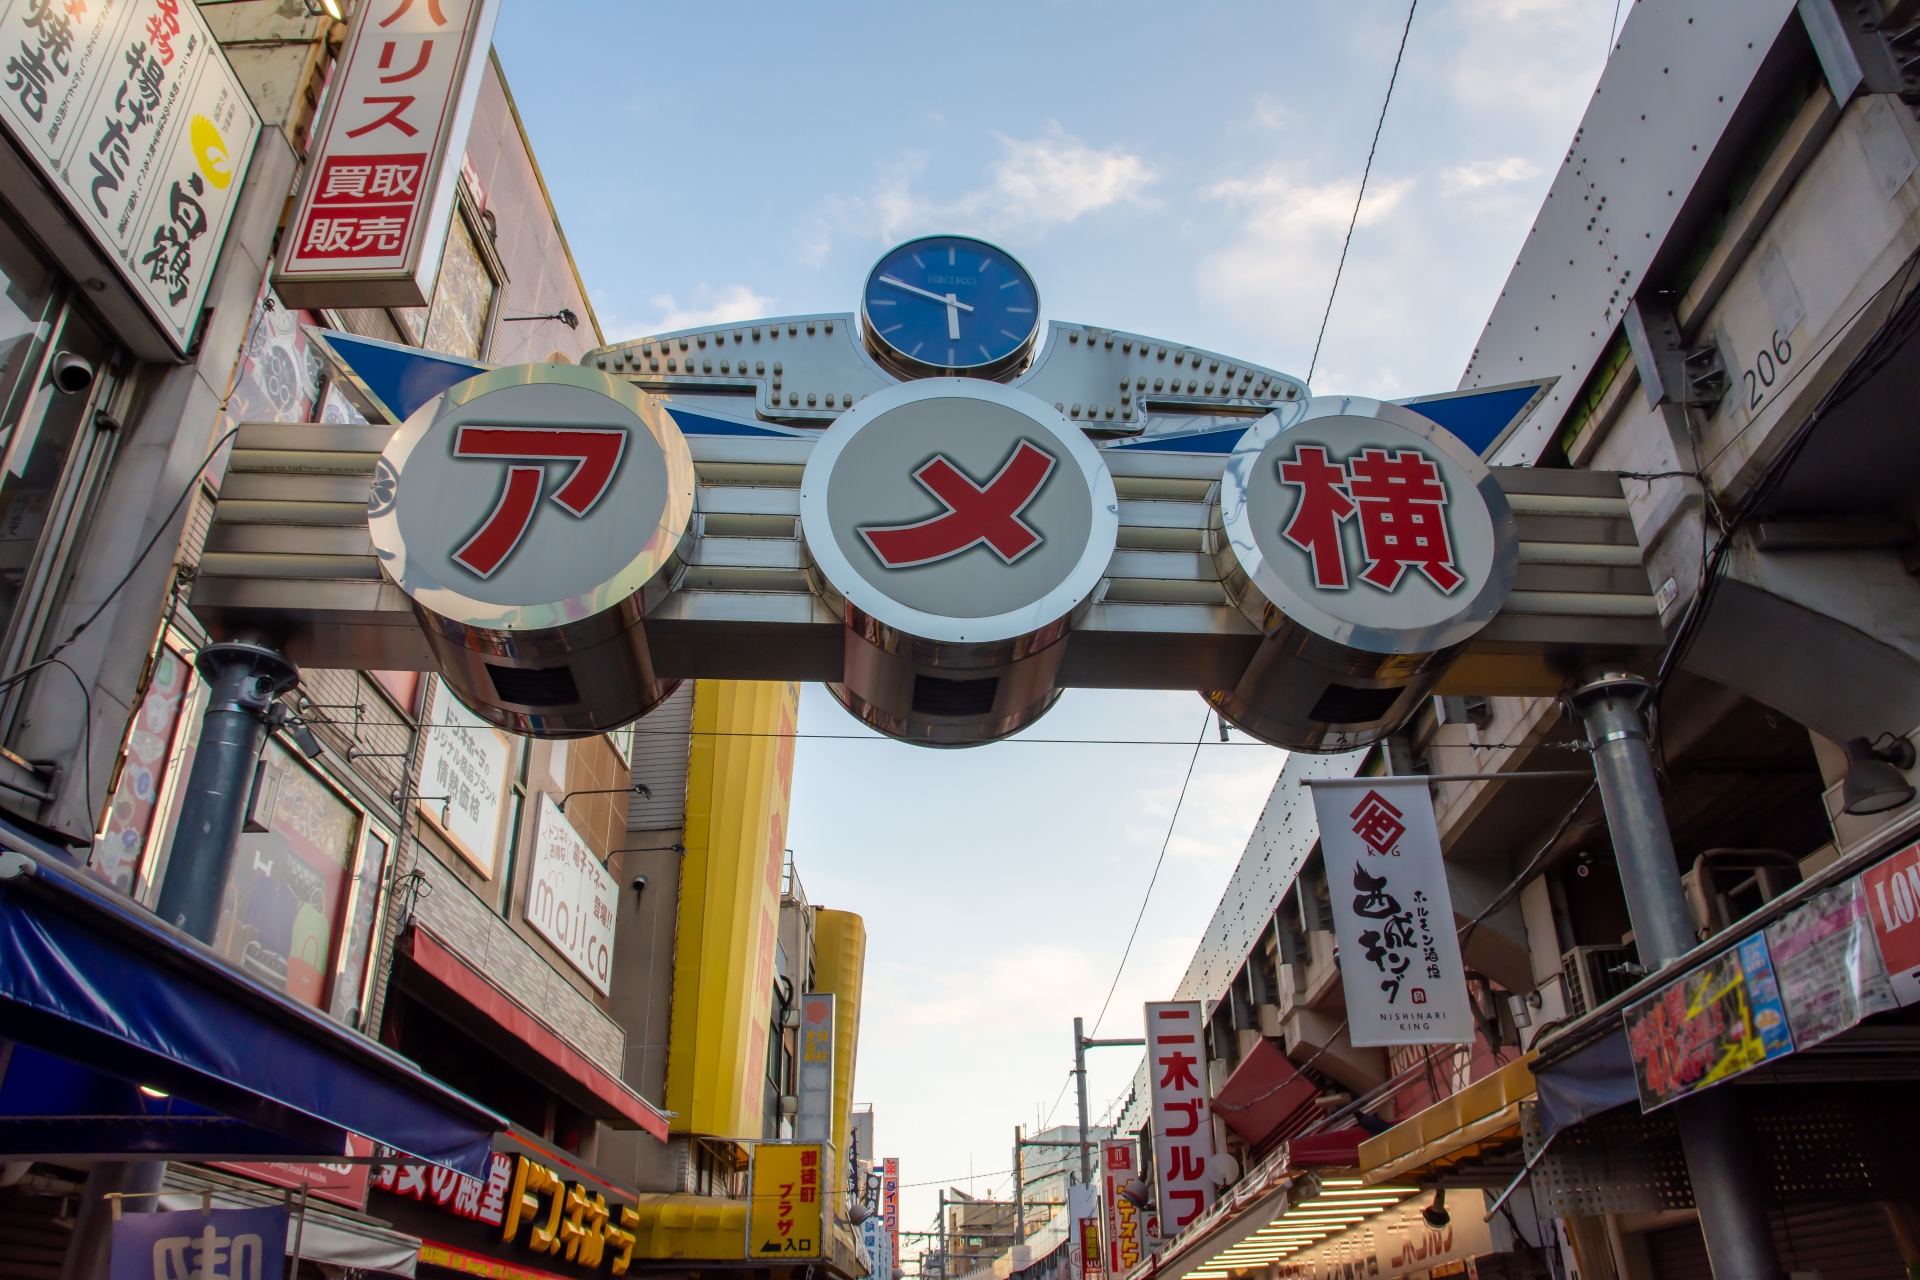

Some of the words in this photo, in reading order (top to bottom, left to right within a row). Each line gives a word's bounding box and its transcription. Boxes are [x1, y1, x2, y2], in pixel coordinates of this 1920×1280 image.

[91, 40, 166, 219] 揚げたて
[321, 163, 419, 199] 買取
[142, 171, 208, 307] 白鶴
[303, 216, 405, 252] 販売
[927, 275, 977, 285] SEIKO
[1744, 330, 1793, 411] 206
[437, 755, 480, 824] 情熱価格
[573, 841, 607, 891] 電子マネー
[1352, 859, 1418, 1004] 西成キング
[1379, 1011, 1447, 1022] NISHINARI
[1399, 1022, 1431, 1032] KING
[1685, 1000, 1726, 1050] SALE
[1681, 1043, 1716, 1083] OFF
[1157, 1010, 1205, 1226] 二木ゴルフ
[801, 1150, 817, 1203] 御徒町
[885, 1159, 897, 1175] 薬
[777, 1181, 795, 1237] プラザ
[886, 1181, 896, 1228] ダイコク
[784, 1238, 812, 1252] 入口
